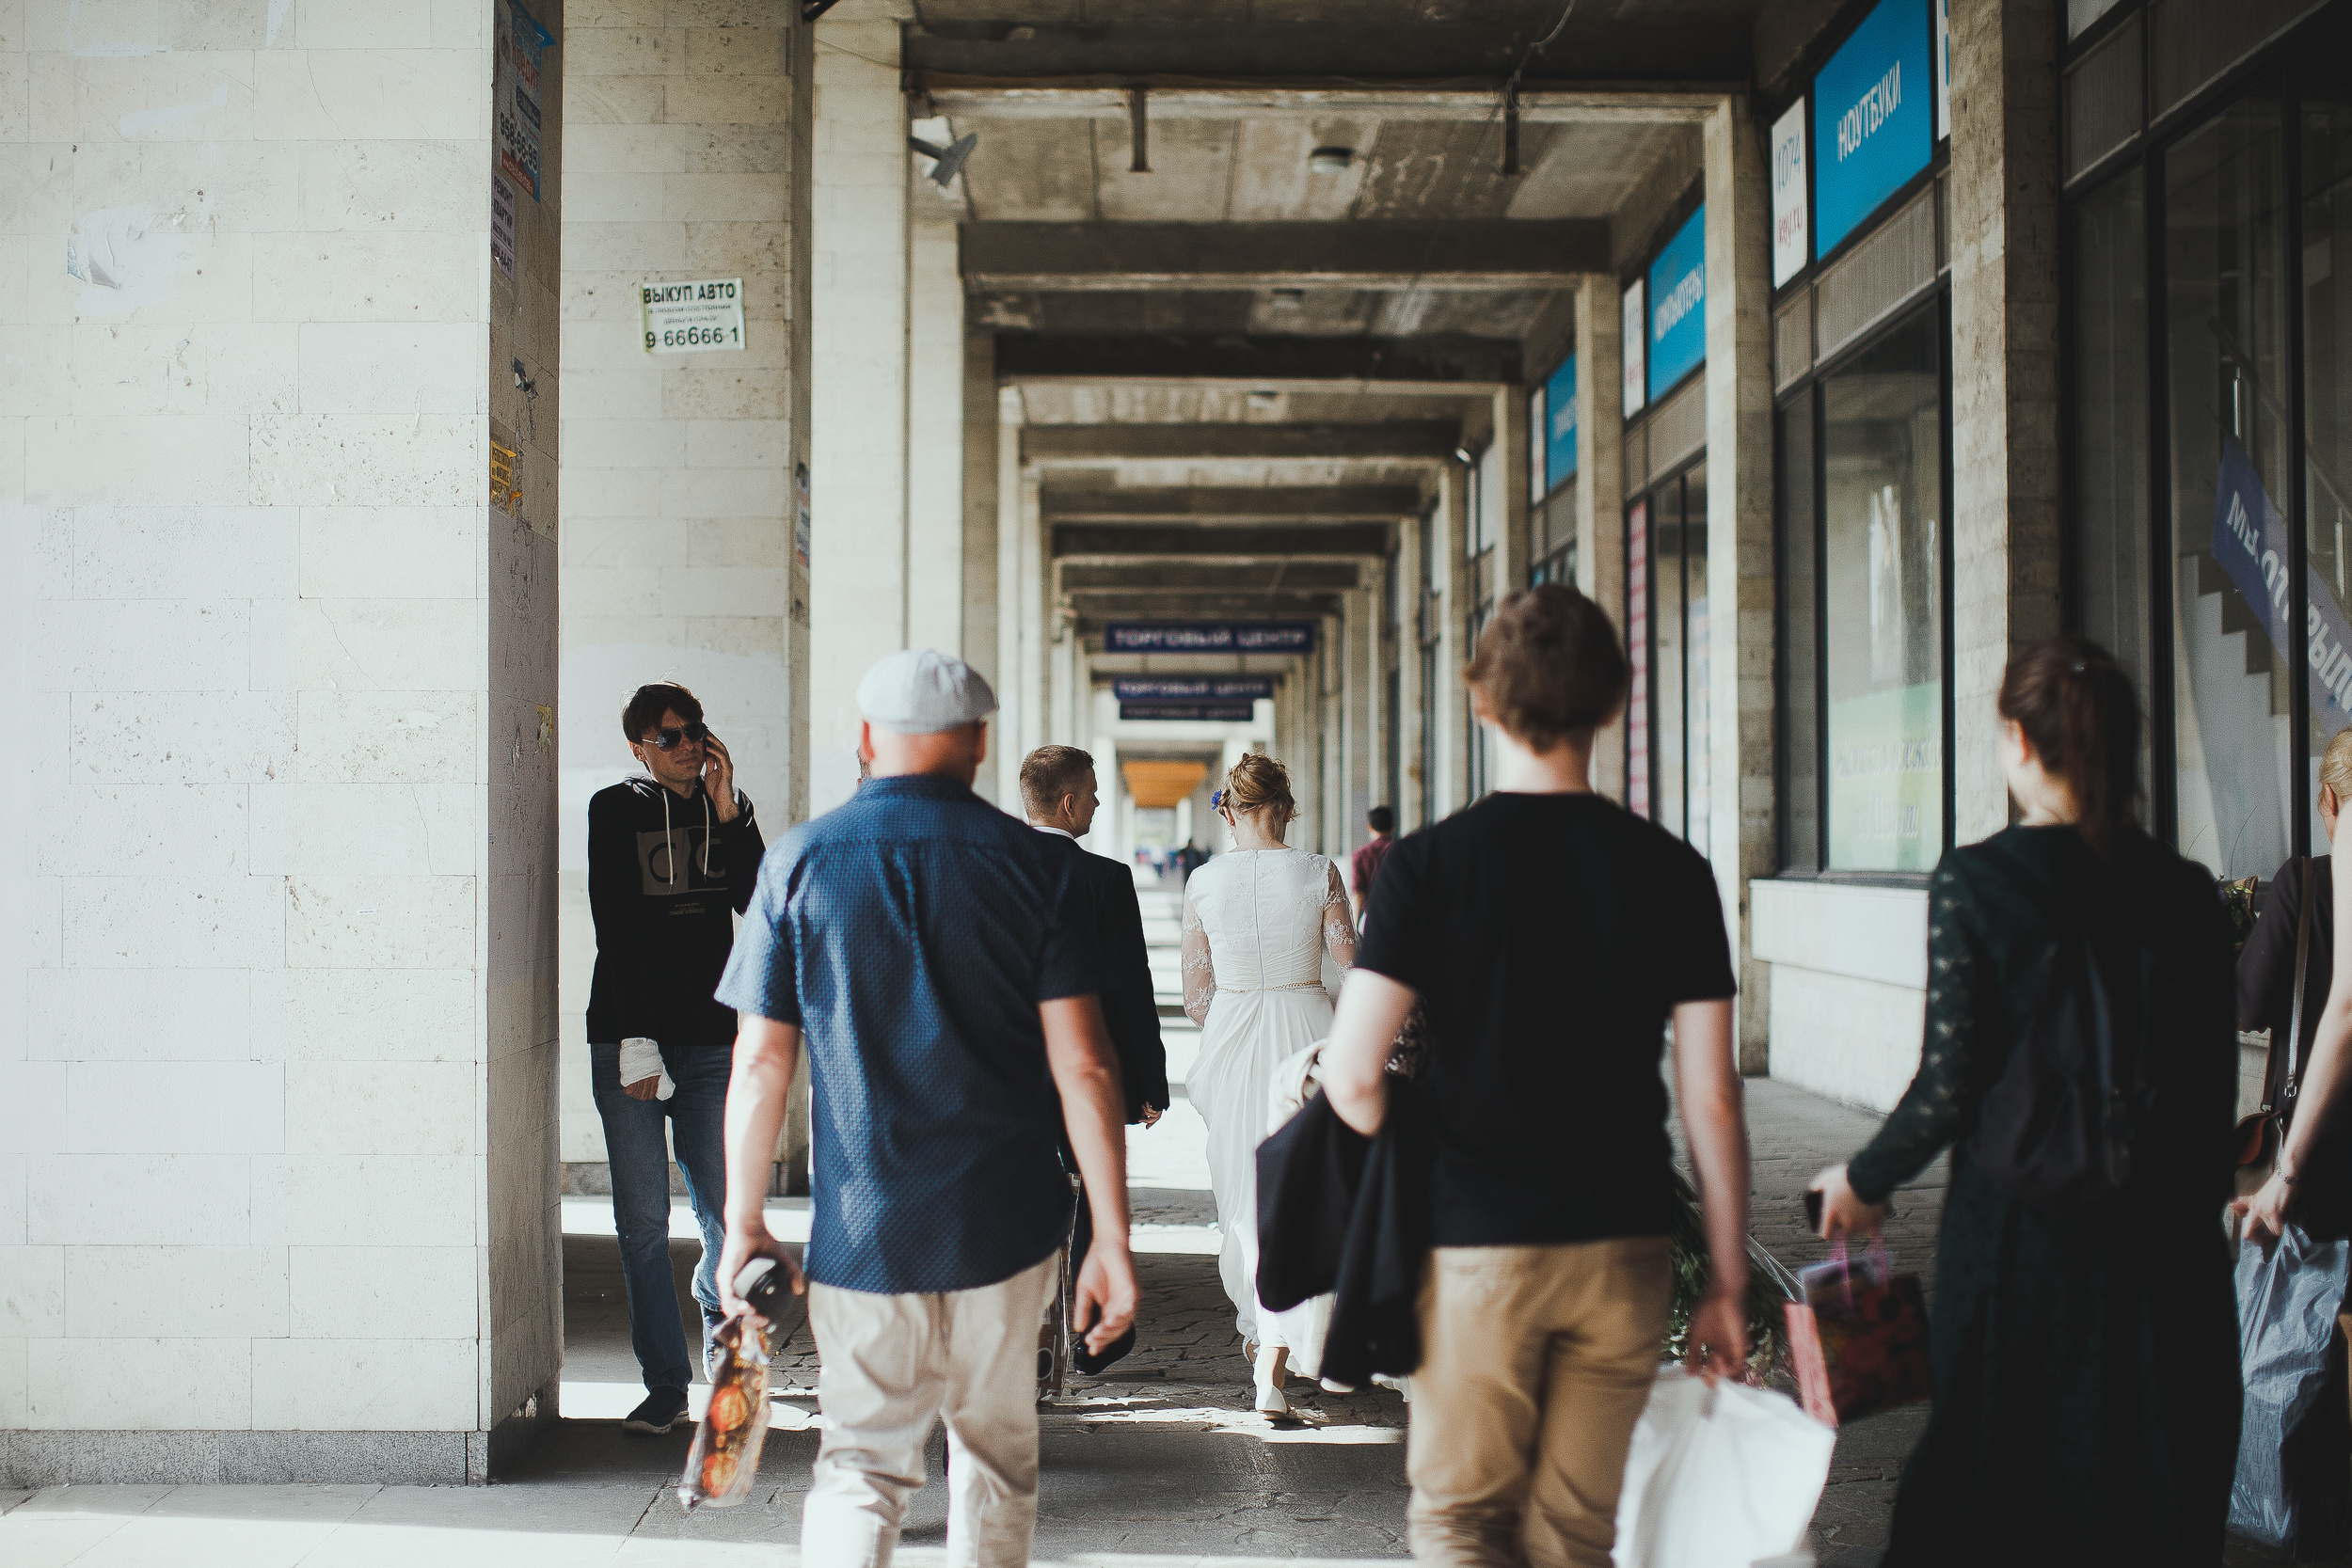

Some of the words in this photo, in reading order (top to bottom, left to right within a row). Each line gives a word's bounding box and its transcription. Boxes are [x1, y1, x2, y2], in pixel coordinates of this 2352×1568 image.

[1837, 59, 1901, 164] НОУТБУКИ
[500, 111, 539, 172] 958-66-95
[1777, 130, 1802, 192] 1074
[1778, 205, 1804, 248] key.ru
[644, 285, 692, 304] ВЫКУП
[698, 282, 736, 300] АВТО
[1114, 628, 1232, 647] ТОРГОВЫЙ
[1236, 630, 1308, 647] ЦЕНТР
